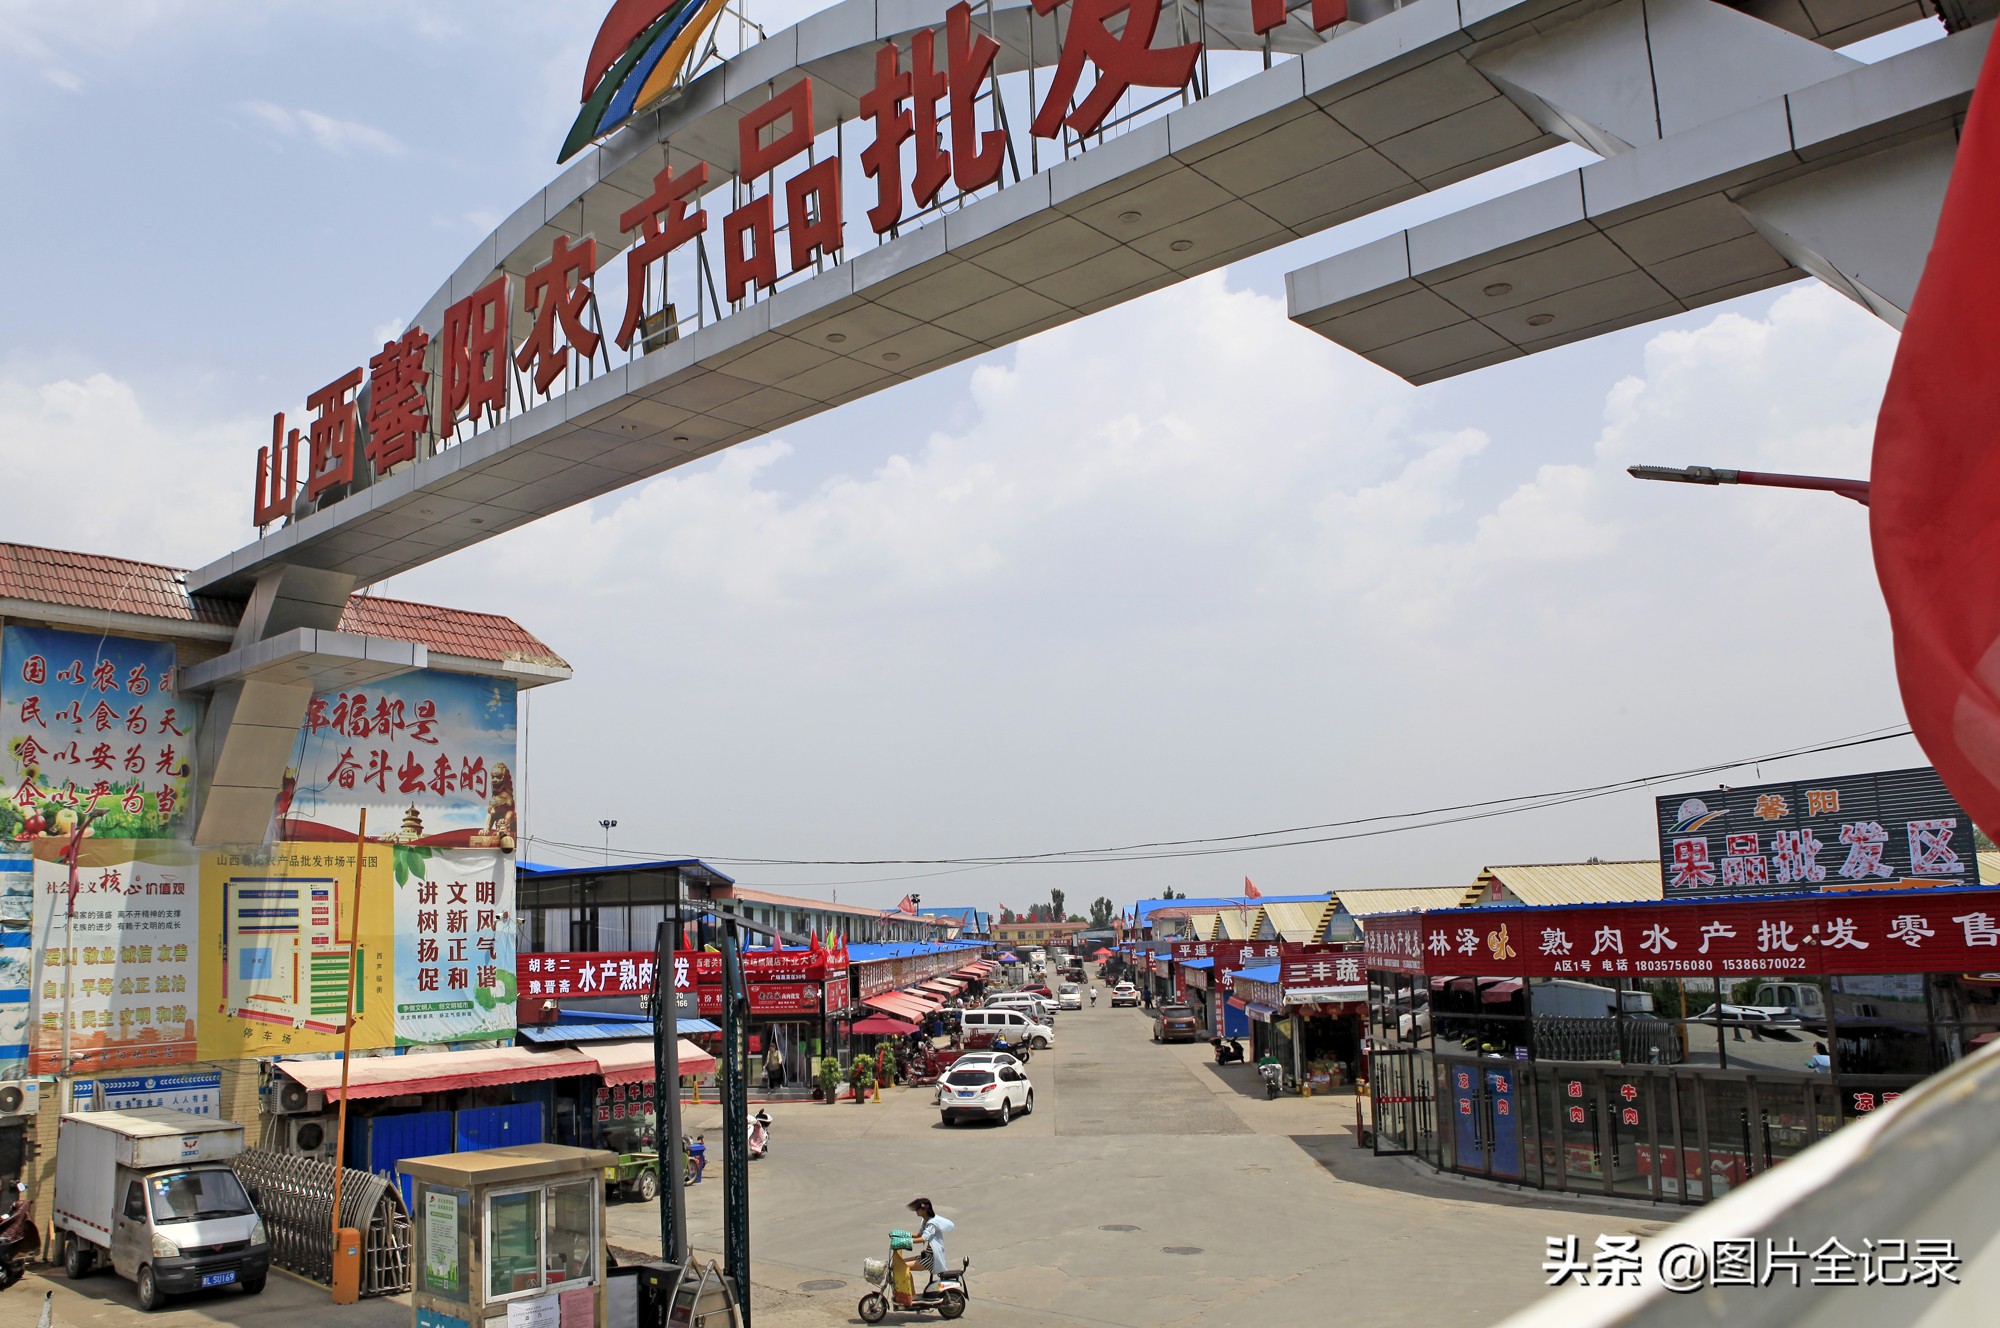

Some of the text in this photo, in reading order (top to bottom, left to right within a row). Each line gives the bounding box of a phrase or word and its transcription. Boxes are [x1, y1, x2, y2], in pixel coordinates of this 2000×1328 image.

[253, 0, 1347, 527] 山西馨阳农产品批发
[20, 696, 184, 737] 民以食为天
[302, 692, 439, 744] 幸福都是
[14, 734, 183, 777] 食以安为先
[327, 746, 488, 799] 奋斗出来的
[12, 776, 177, 815] 企以严为当
[1753, 789, 1841, 820] 馨阳
[1670, 818, 1965, 888] 果品批发区
[416, 881, 496, 905] 讲文明
[117, 909, 182, 919] 离不开精神的支撑
[117, 921, 181, 930] 有赖于文明的成长
[416, 909, 497, 934] 树新风
[1538, 911, 2000, 956] 熟肉水产批发零售
[83, 946, 116, 965] 敬业
[121, 945, 153, 964] 诚信
[157, 944, 189, 963] 友善
[417, 937, 497, 963] 扬正气
[528, 958, 571, 973] 胡老二
[577, 957, 691, 993] 水产熟肉发
[1288, 957, 1367, 982] 三丰蔬
[1554, 957, 1806, 972] A区1号 电话 18035756080 15386870022
[80, 978, 114, 998] 平等
[118, 977, 150, 995] 公正
[155, 975, 187, 994] 法治
[417, 965, 497, 992] 促和谐
[529, 979, 571, 994] 豫晋斋
[81, 1009, 114, 1028] 民主
[119, 1007, 151, 1026] 文明
[156, 1005, 187, 1024] 和谐
[243, 1027, 292, 1045] 停车场
[597, 1083, 655, 1103] 平遥牛肉
[1458, 1072, 1472, 1115] 凉菜
[1496, 1075, 1509, 1115] 头肉
[1568, 1081, 1584, 1123] 卤肉
[1621, 1083, 1639, 1125] 牛肉
[598, 1100, 654, 1121] 正宗驴肉
